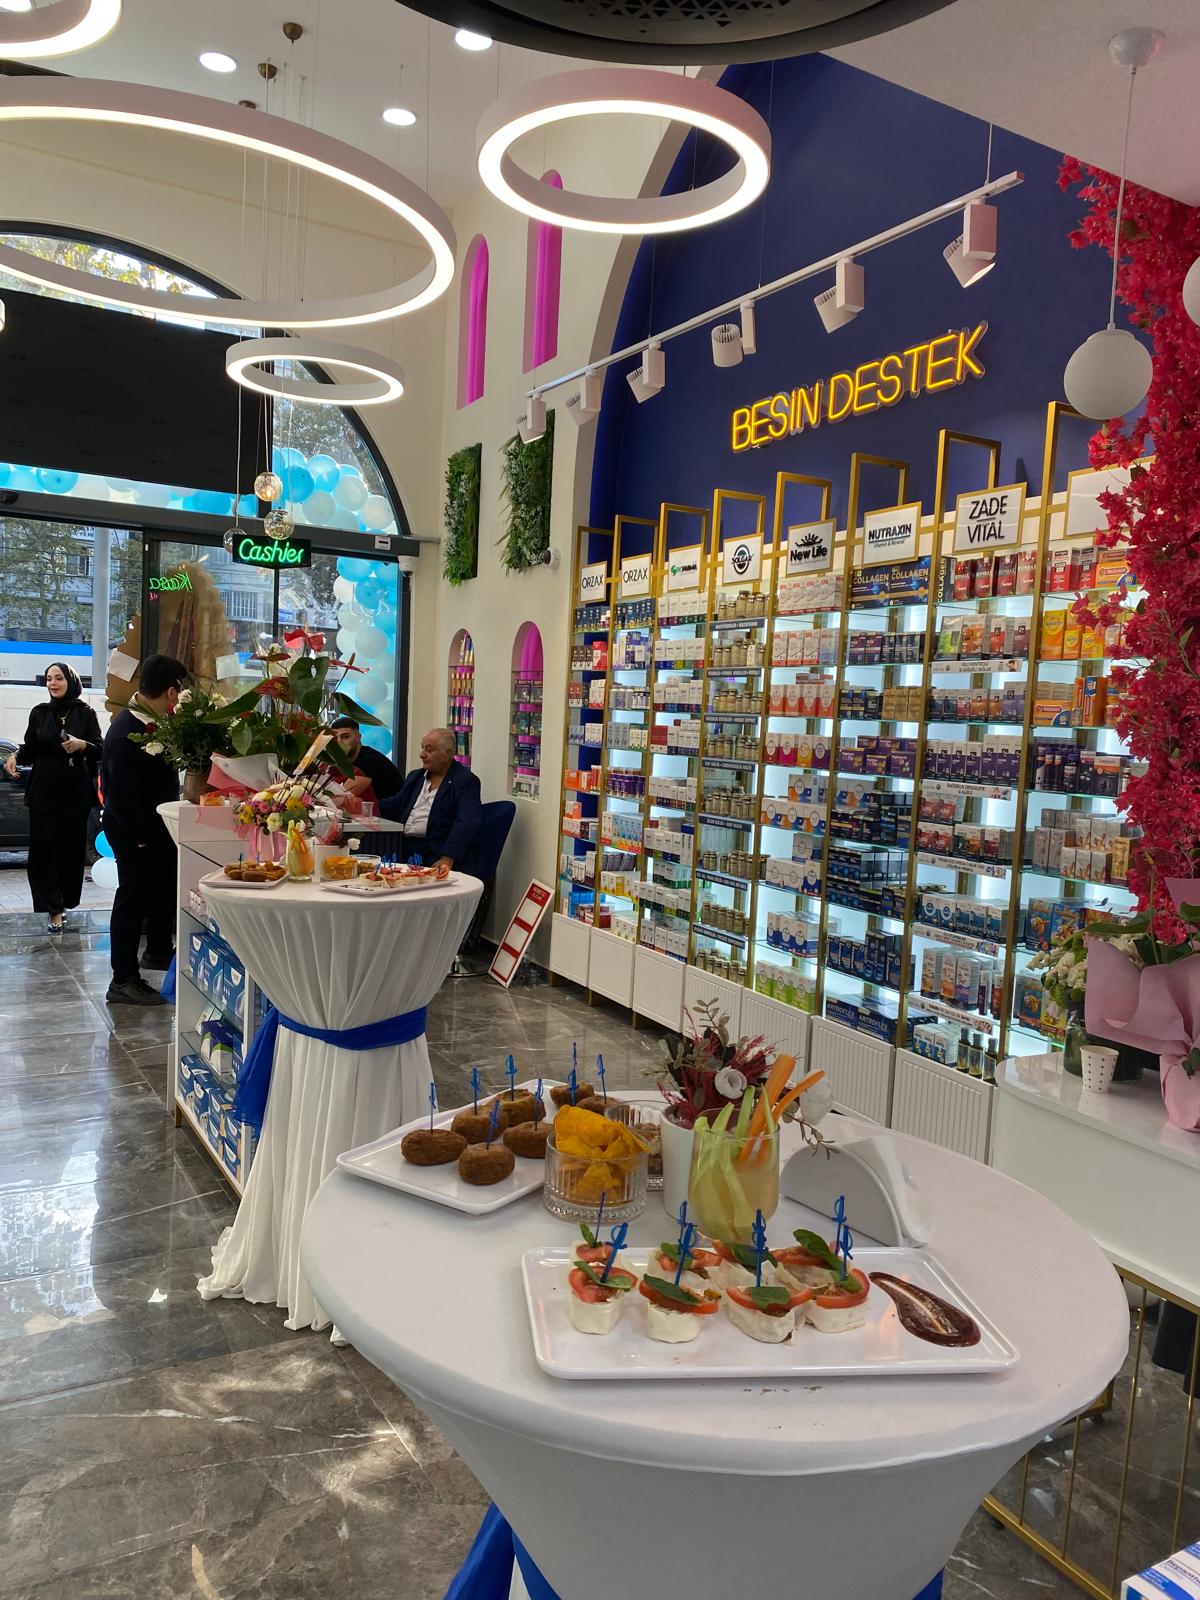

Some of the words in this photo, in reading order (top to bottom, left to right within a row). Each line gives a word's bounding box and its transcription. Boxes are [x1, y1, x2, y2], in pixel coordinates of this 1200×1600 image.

[828, 324, 984, 419] DESTEK
[969, 495, 1008, 520] ZADE
[868, 523, 912, 540] NUTRAXIN
[967, 521, 1005, 543] VITAL
[239, 538, 304, 563] Cashier
[790, 549, 810, 562] New
[811, 545, 828, 559] Life
[582, 574, 604, 589] ORZAX
[623, 567, 648, 583] ORZAX
[853, 573, 889, 584] COLLAGEN
[891, 568, 929, 580] COLLAGEN
[827, 1003, 855, 1019] ARTROFLEX
[859, 1015, 888, 1031] ARTROFLEX
